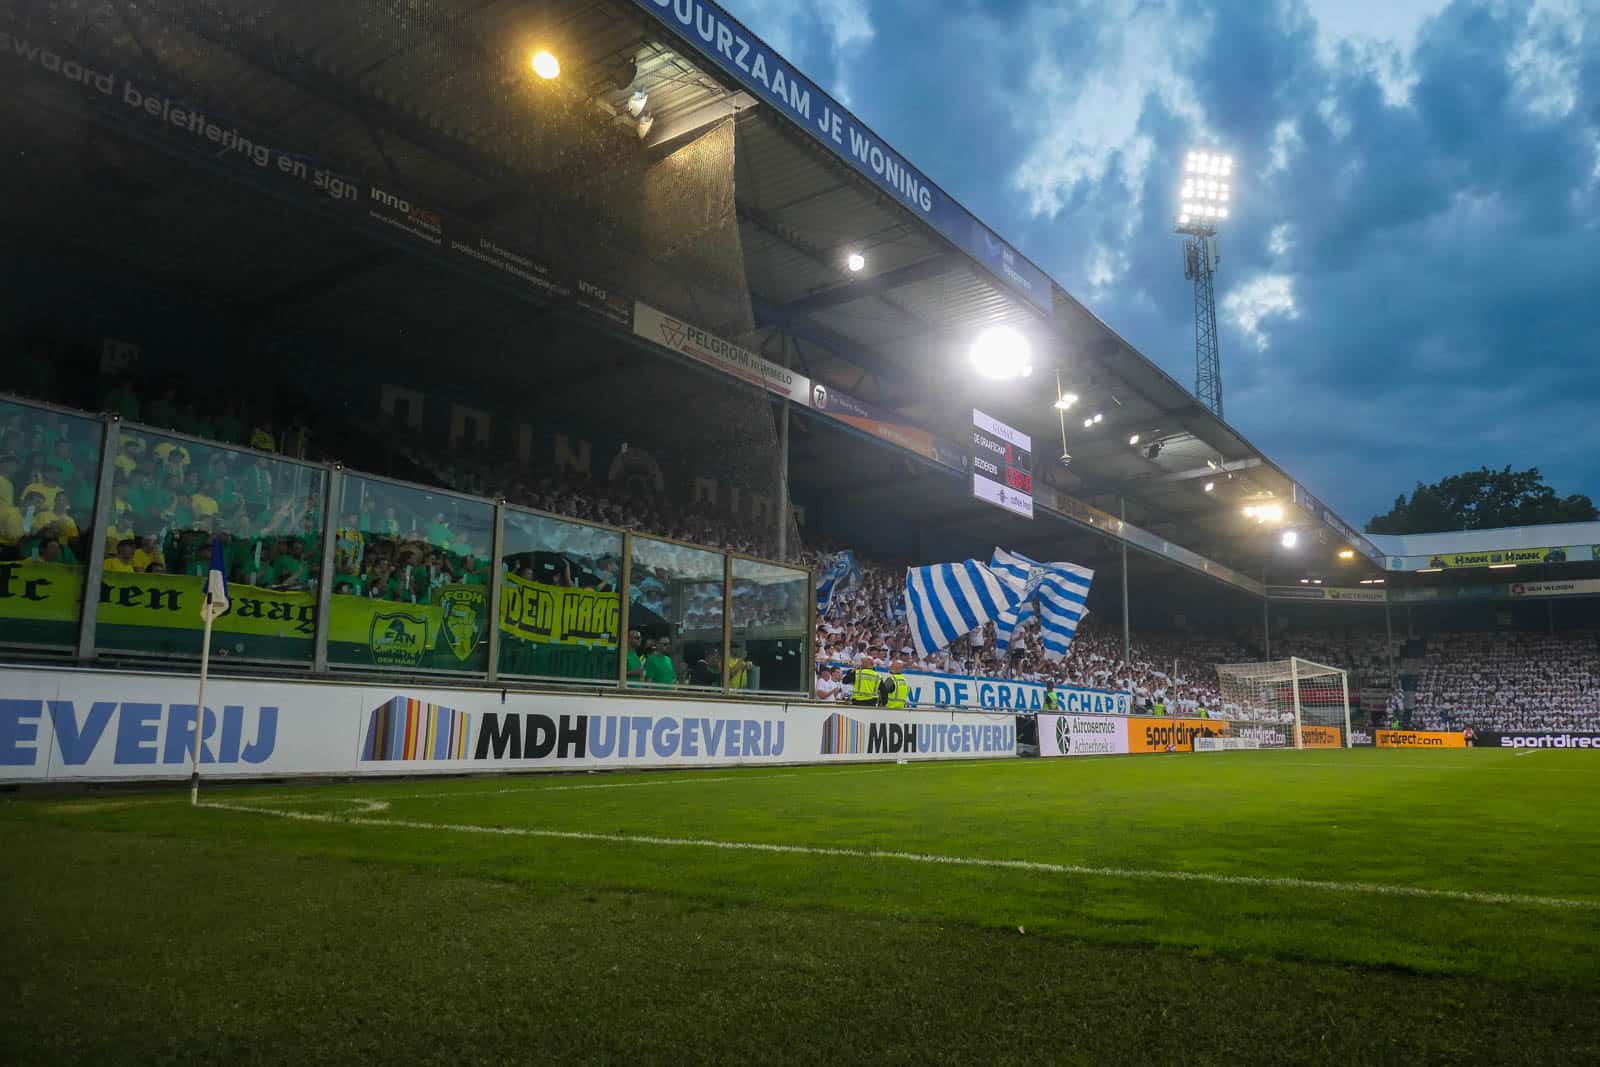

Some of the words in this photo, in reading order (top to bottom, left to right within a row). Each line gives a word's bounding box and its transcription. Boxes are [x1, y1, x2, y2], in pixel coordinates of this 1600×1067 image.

[653, 0, 810, 120] UURZAAM
[818, 107, 842, 144] JE
[850, 127, 931, 211] WONING
[123, 80, 271, 167] belettering
[277, 157, 306, 179] en
[313, 169, 358, 201] sign
[687, 327, 749, 369] PELGROM
[502, 586, 554, 636] DEN
[560, 592, 620, 643] HAAG
[935, 681, 970, 709] DE
[980, 684, 1114, 713] GRAASCHAP
[1073, 717, 1116, 733] Aircoservice
